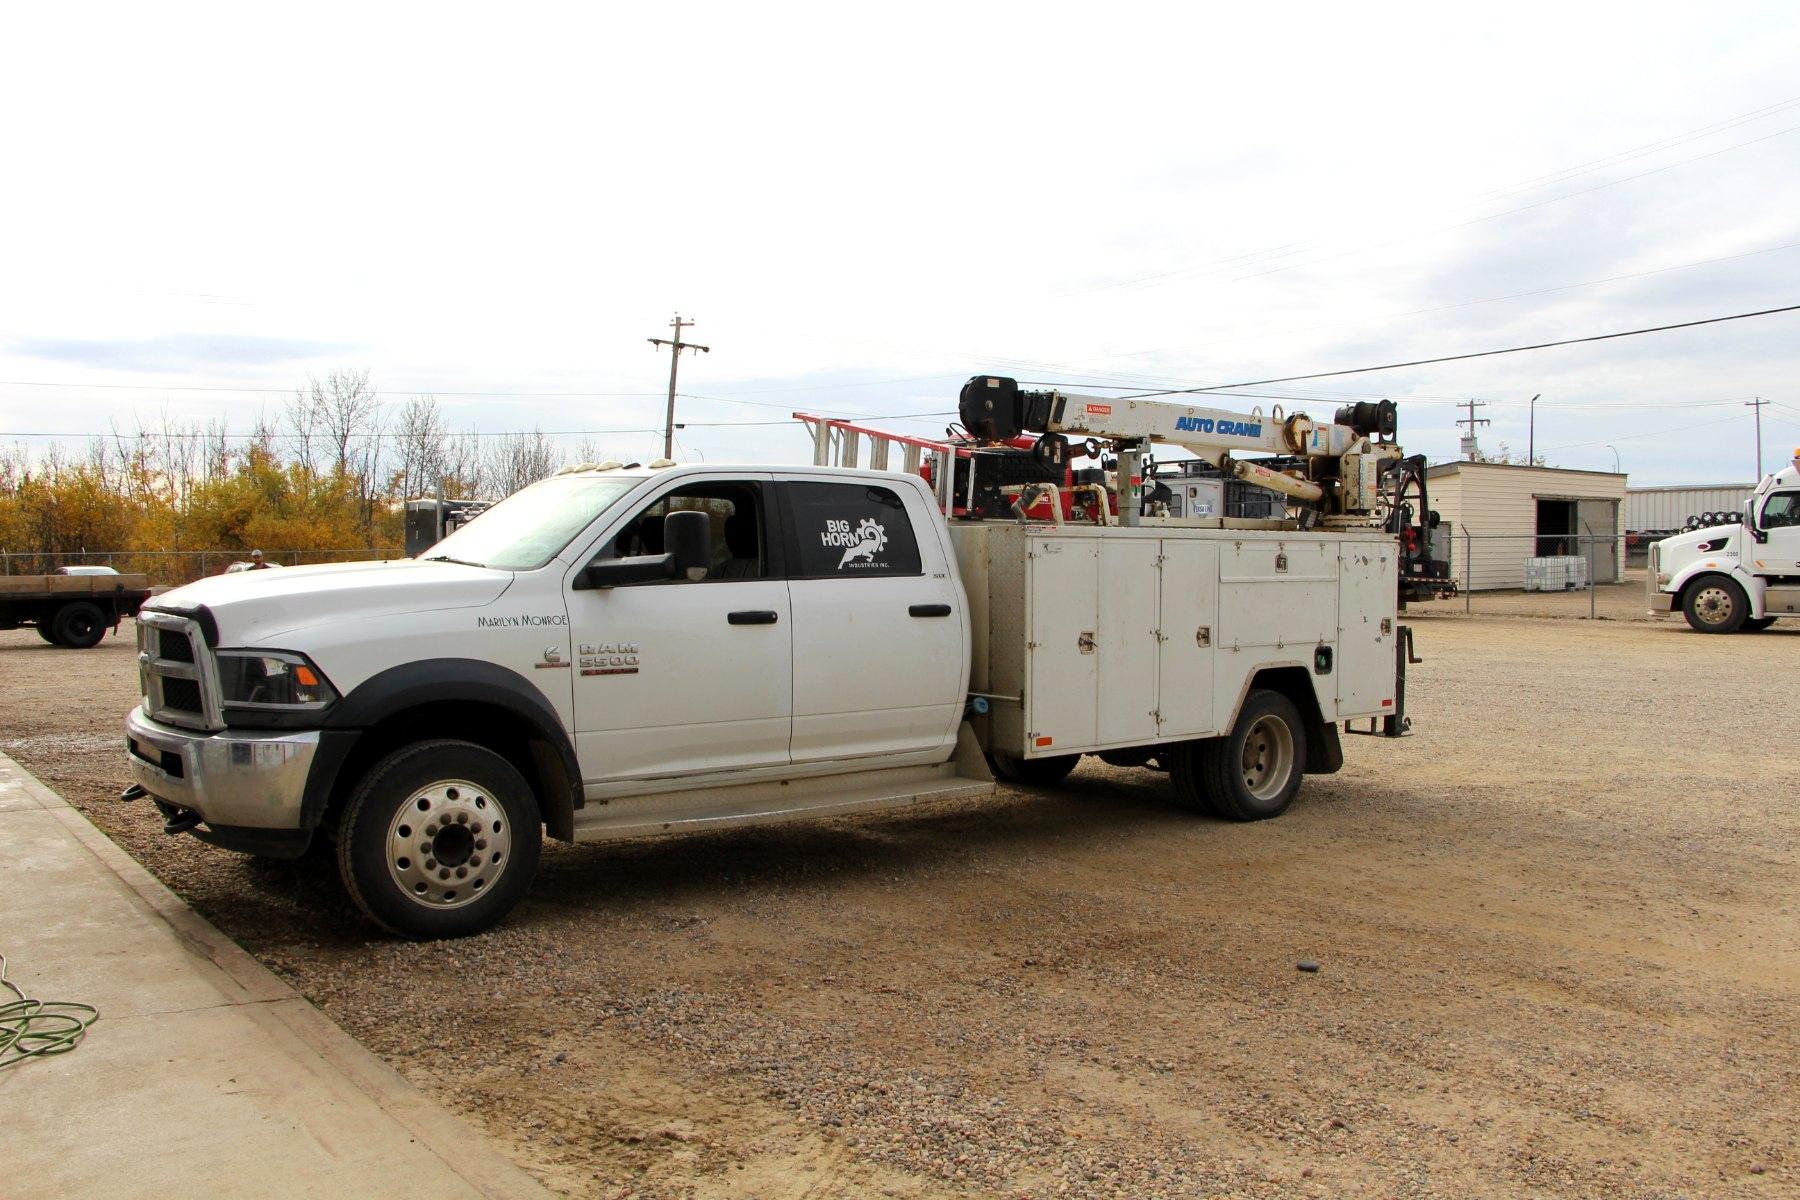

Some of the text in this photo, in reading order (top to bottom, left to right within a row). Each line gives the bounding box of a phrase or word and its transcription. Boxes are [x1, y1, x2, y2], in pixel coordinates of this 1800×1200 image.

[1175, 416, 1262, 438] AUTO CRANE
[826, 520, 850, 532] BIG
[820, 532, 860, 548] HORN
[579, 643, 640, 656] RAM
[579, 655, 640, 668] 5500
